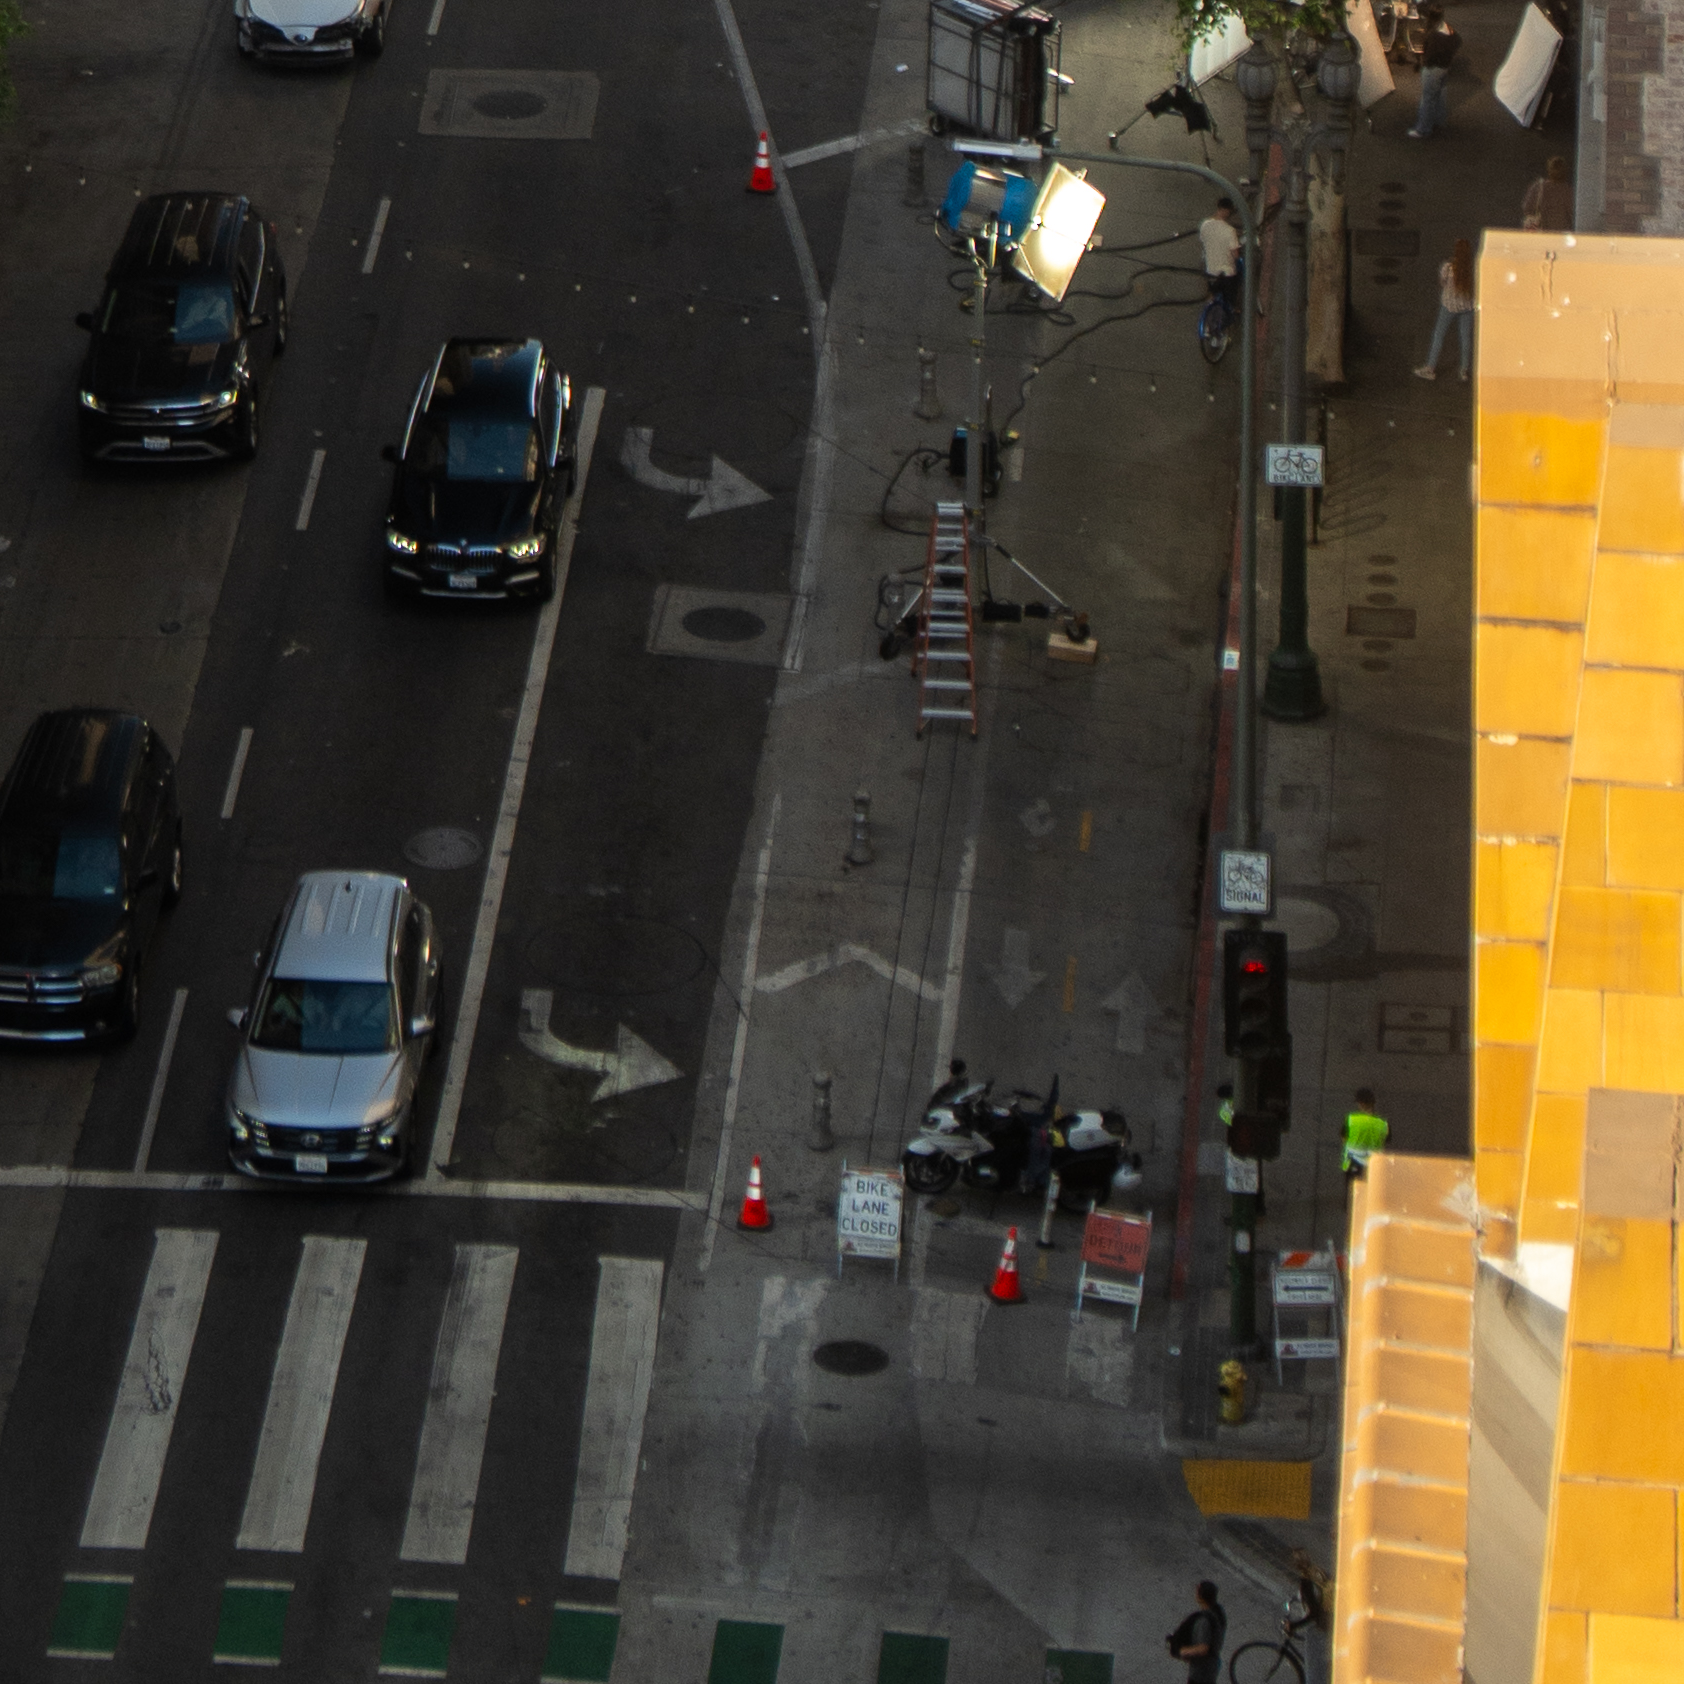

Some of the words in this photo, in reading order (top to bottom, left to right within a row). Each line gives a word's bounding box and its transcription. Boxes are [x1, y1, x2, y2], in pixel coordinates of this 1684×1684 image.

[1226, 888, 1265, 904] SIGNAL
[856, 1179, 889, 1197] BIKE
[852, 1199, 889, 1216] LANE
[842, 1217, 897, 1236] CLOSED
